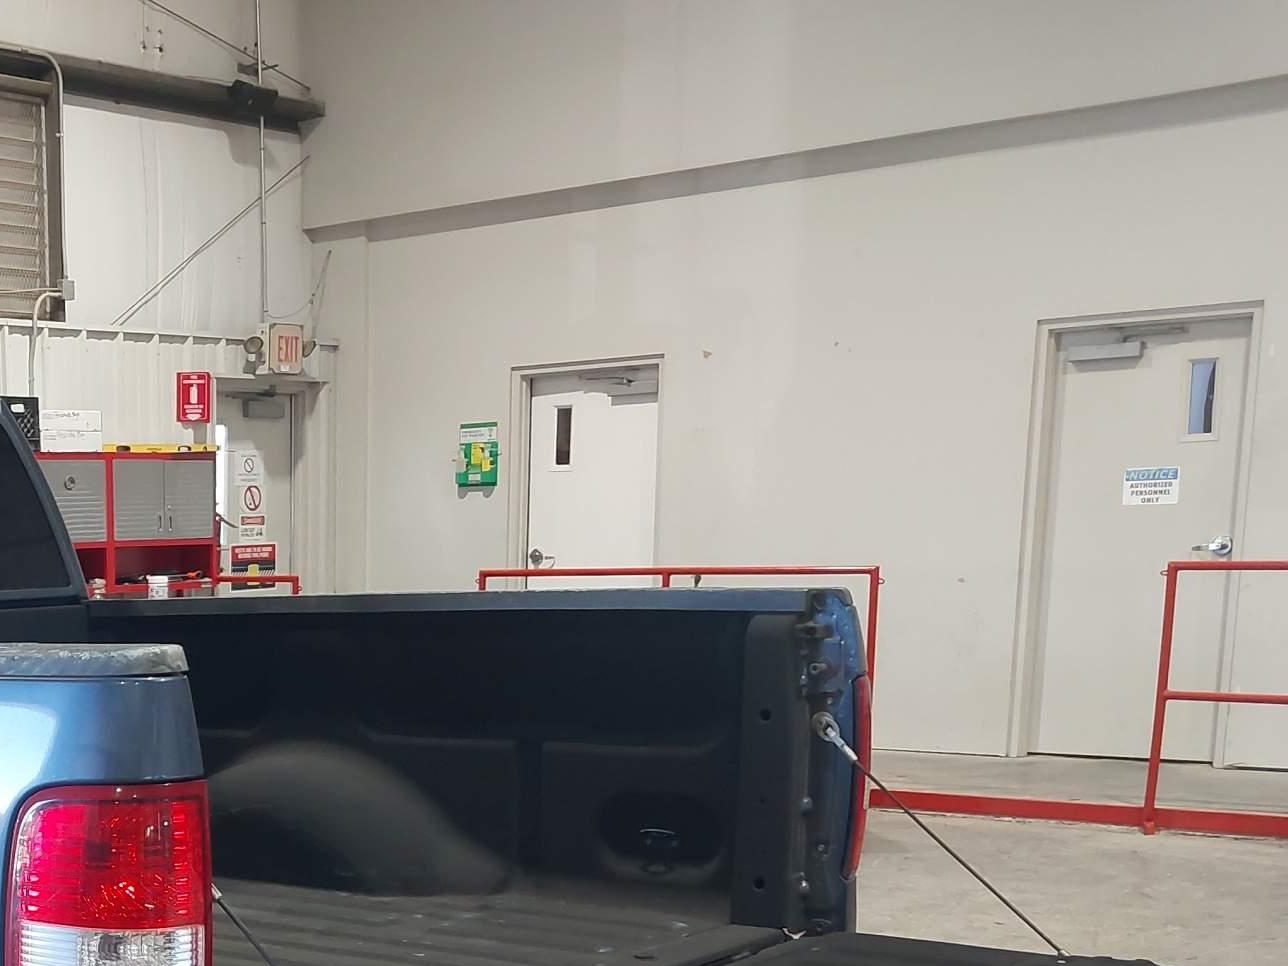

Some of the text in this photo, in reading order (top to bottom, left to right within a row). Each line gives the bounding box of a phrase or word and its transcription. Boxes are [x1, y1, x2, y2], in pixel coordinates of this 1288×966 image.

[277, 335, 300, 363] EXIT
[1129, 469, 1177, 480] NOTICE
[1129, 481, 1173, 489] AUTHORIZED
